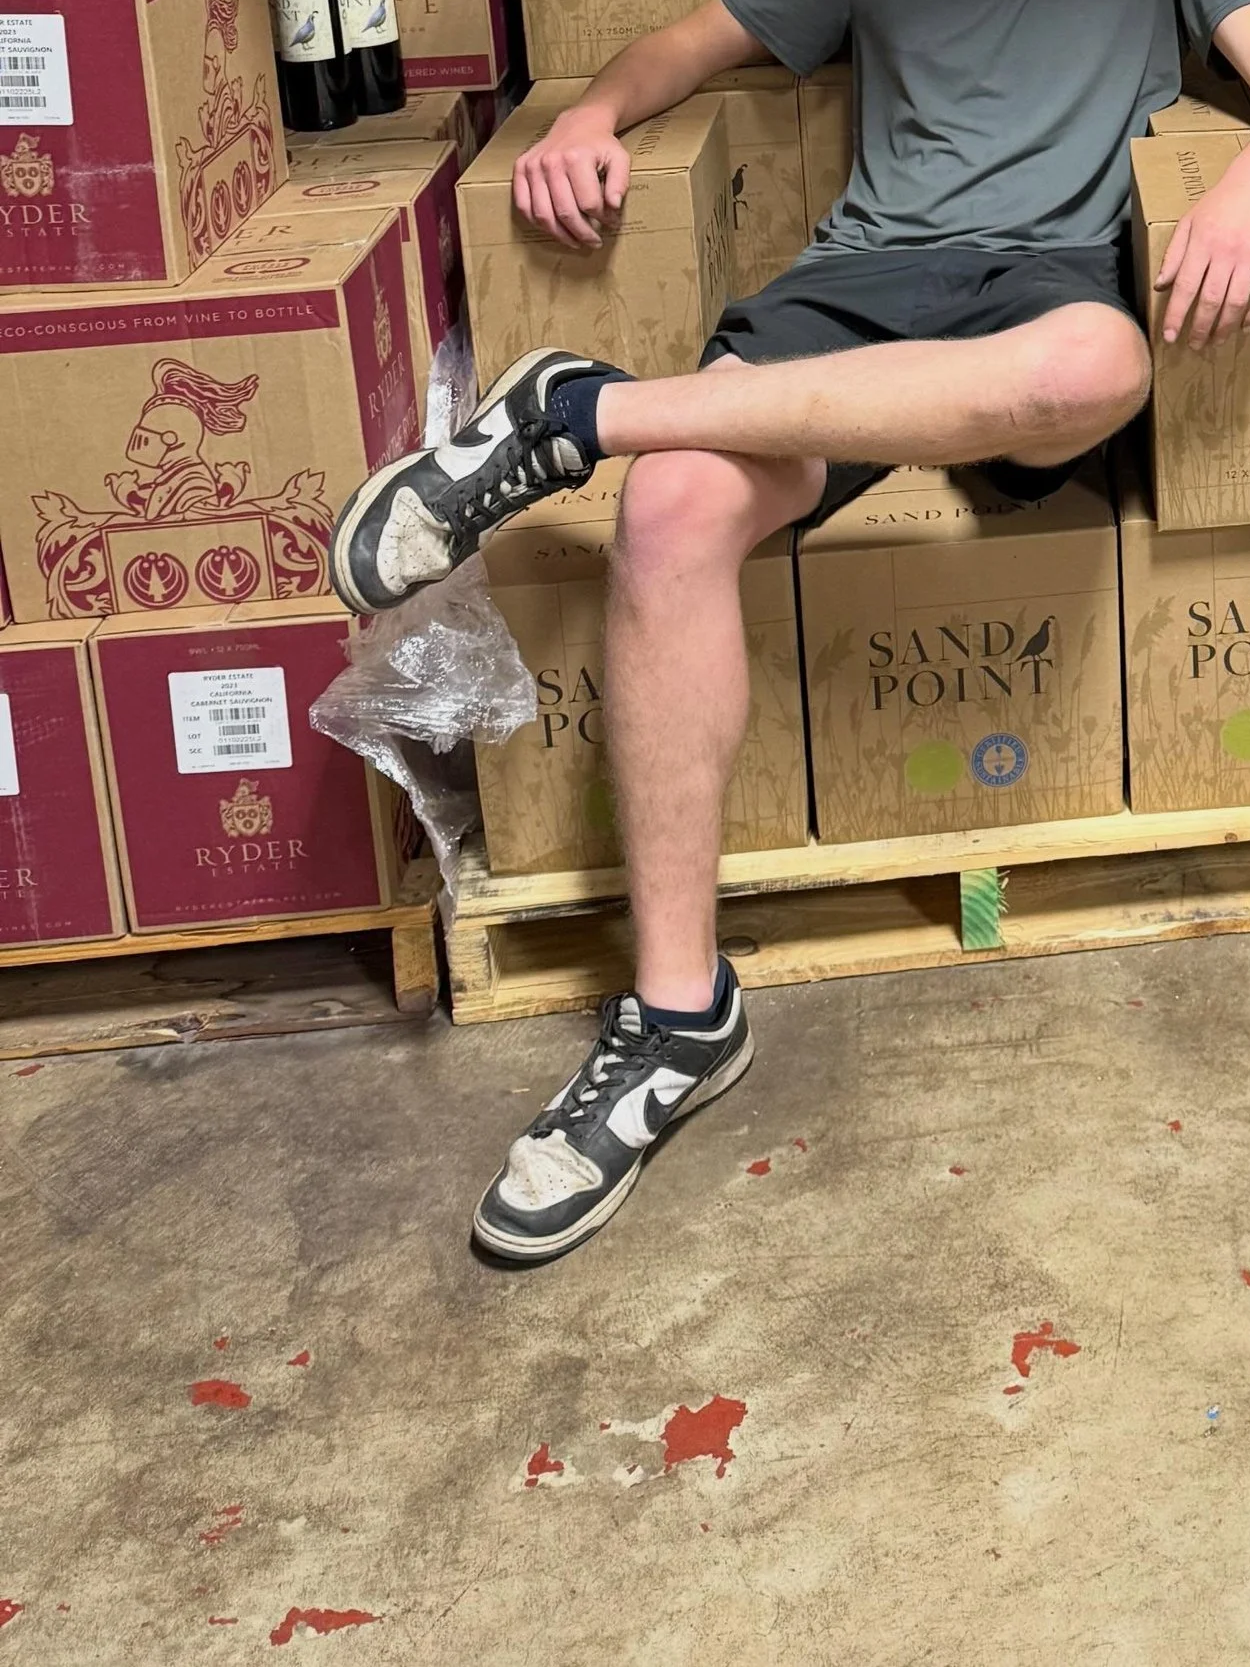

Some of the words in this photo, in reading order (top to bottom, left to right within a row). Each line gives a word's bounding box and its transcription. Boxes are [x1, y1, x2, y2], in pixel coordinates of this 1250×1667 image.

[134, 315, 177, 328] FROM
[184, 313, 221, 324] VINE
[228, 309, 247, 320] TO
[256, 305, 315, 319] BOTTLE
[1225, 470, 1237, 479] 12
[1242, 469, 1249, 478] X
[864, 508, 942, 527] SAND
[869, 620, 1016, 668] SAND
[203, 674, 226, 682] RYDER
[872, 658, 1054, 710] POINT
[209, 690, 253, 698] CALIFORNIA
[229, 697, 273, 705] SAUVIGNON
[196, 839, 310, 867] RYDER
